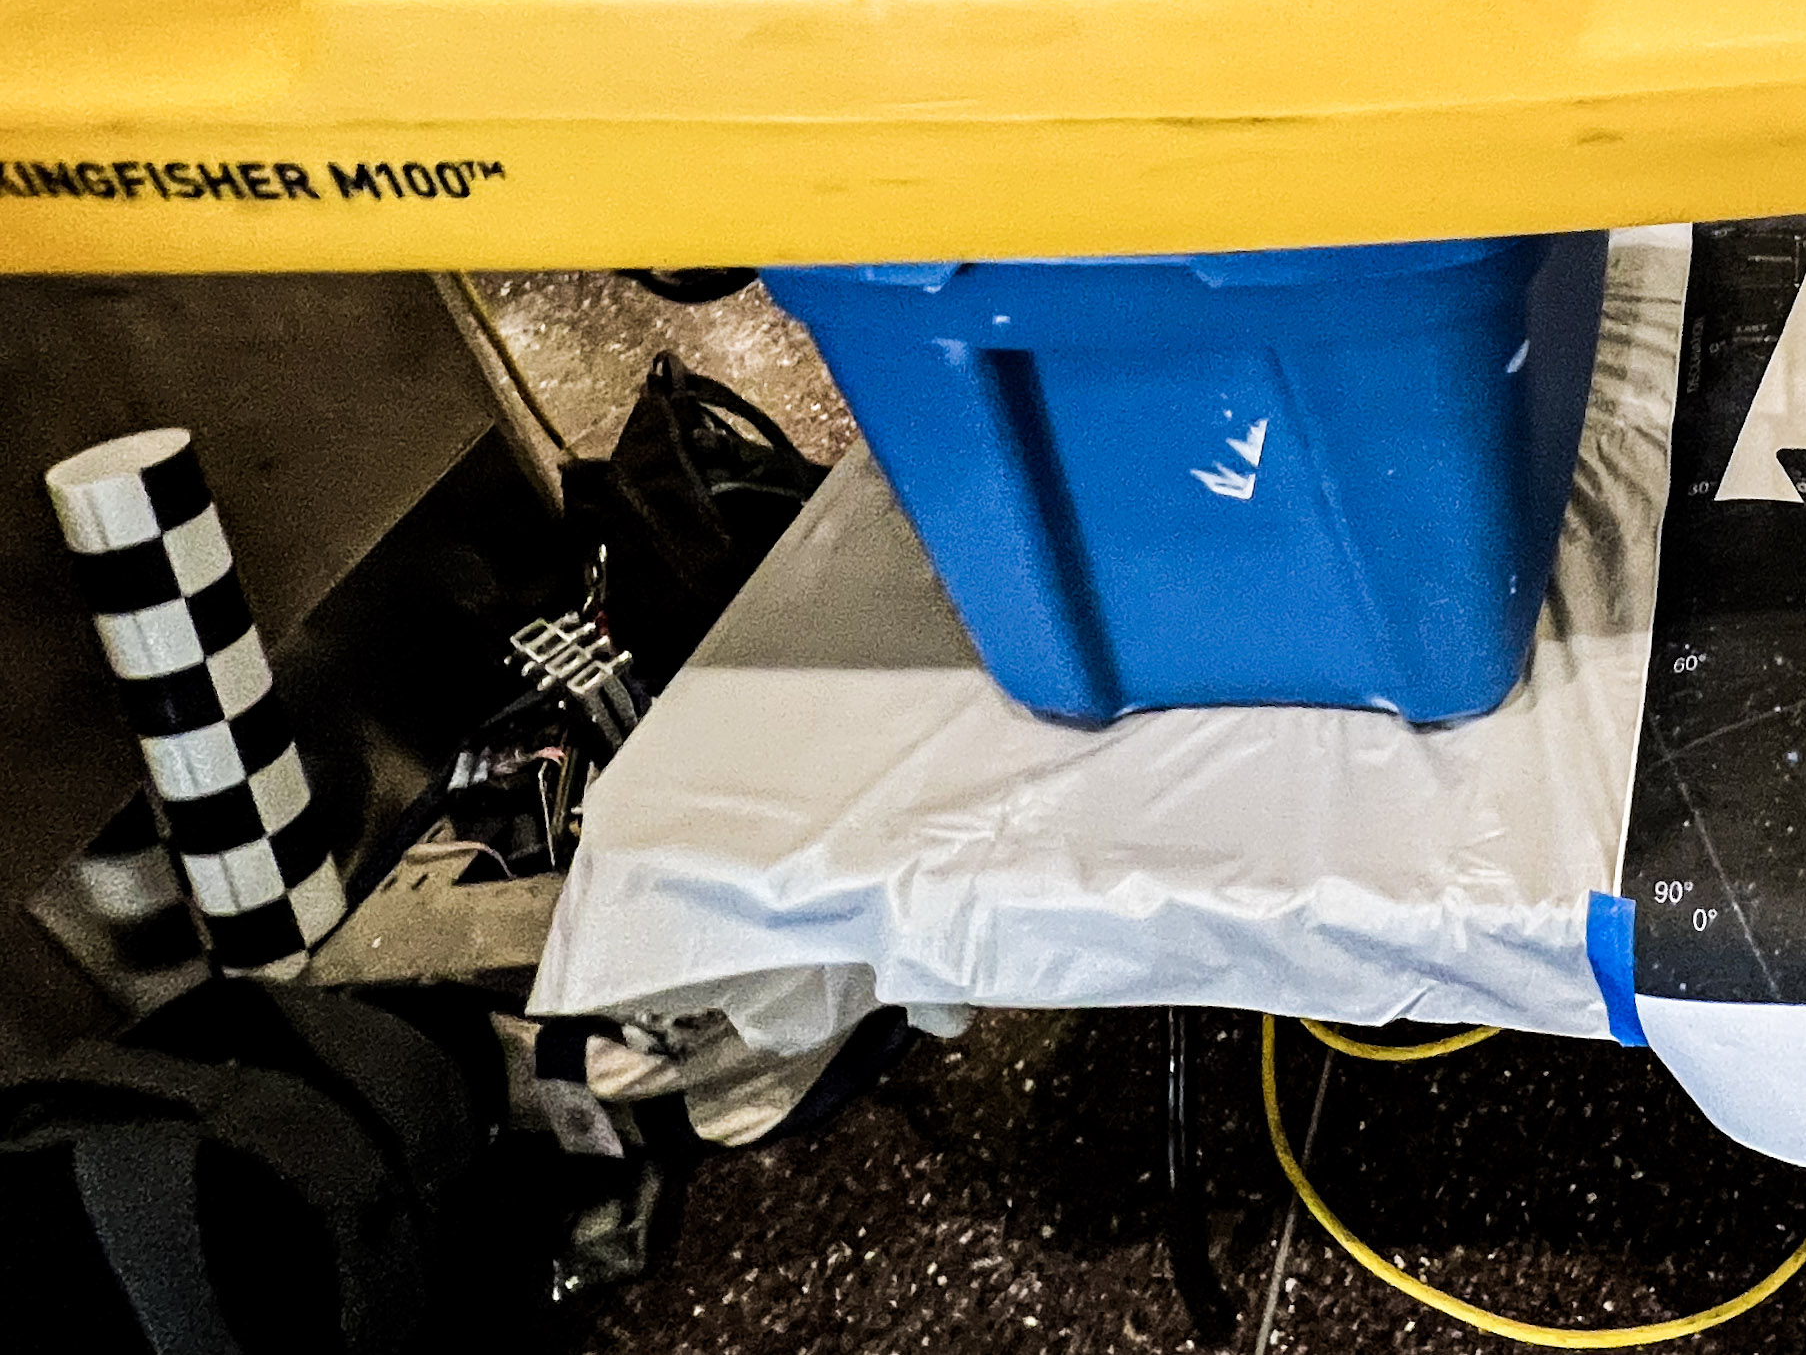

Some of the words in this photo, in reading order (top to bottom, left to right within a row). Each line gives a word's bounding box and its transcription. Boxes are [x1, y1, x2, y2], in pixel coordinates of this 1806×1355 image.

[1673, 653, 1707, 674] 60°
[1653, 881, 1694, 904] 90°
[1692, 908, 1718, 932] 0°
